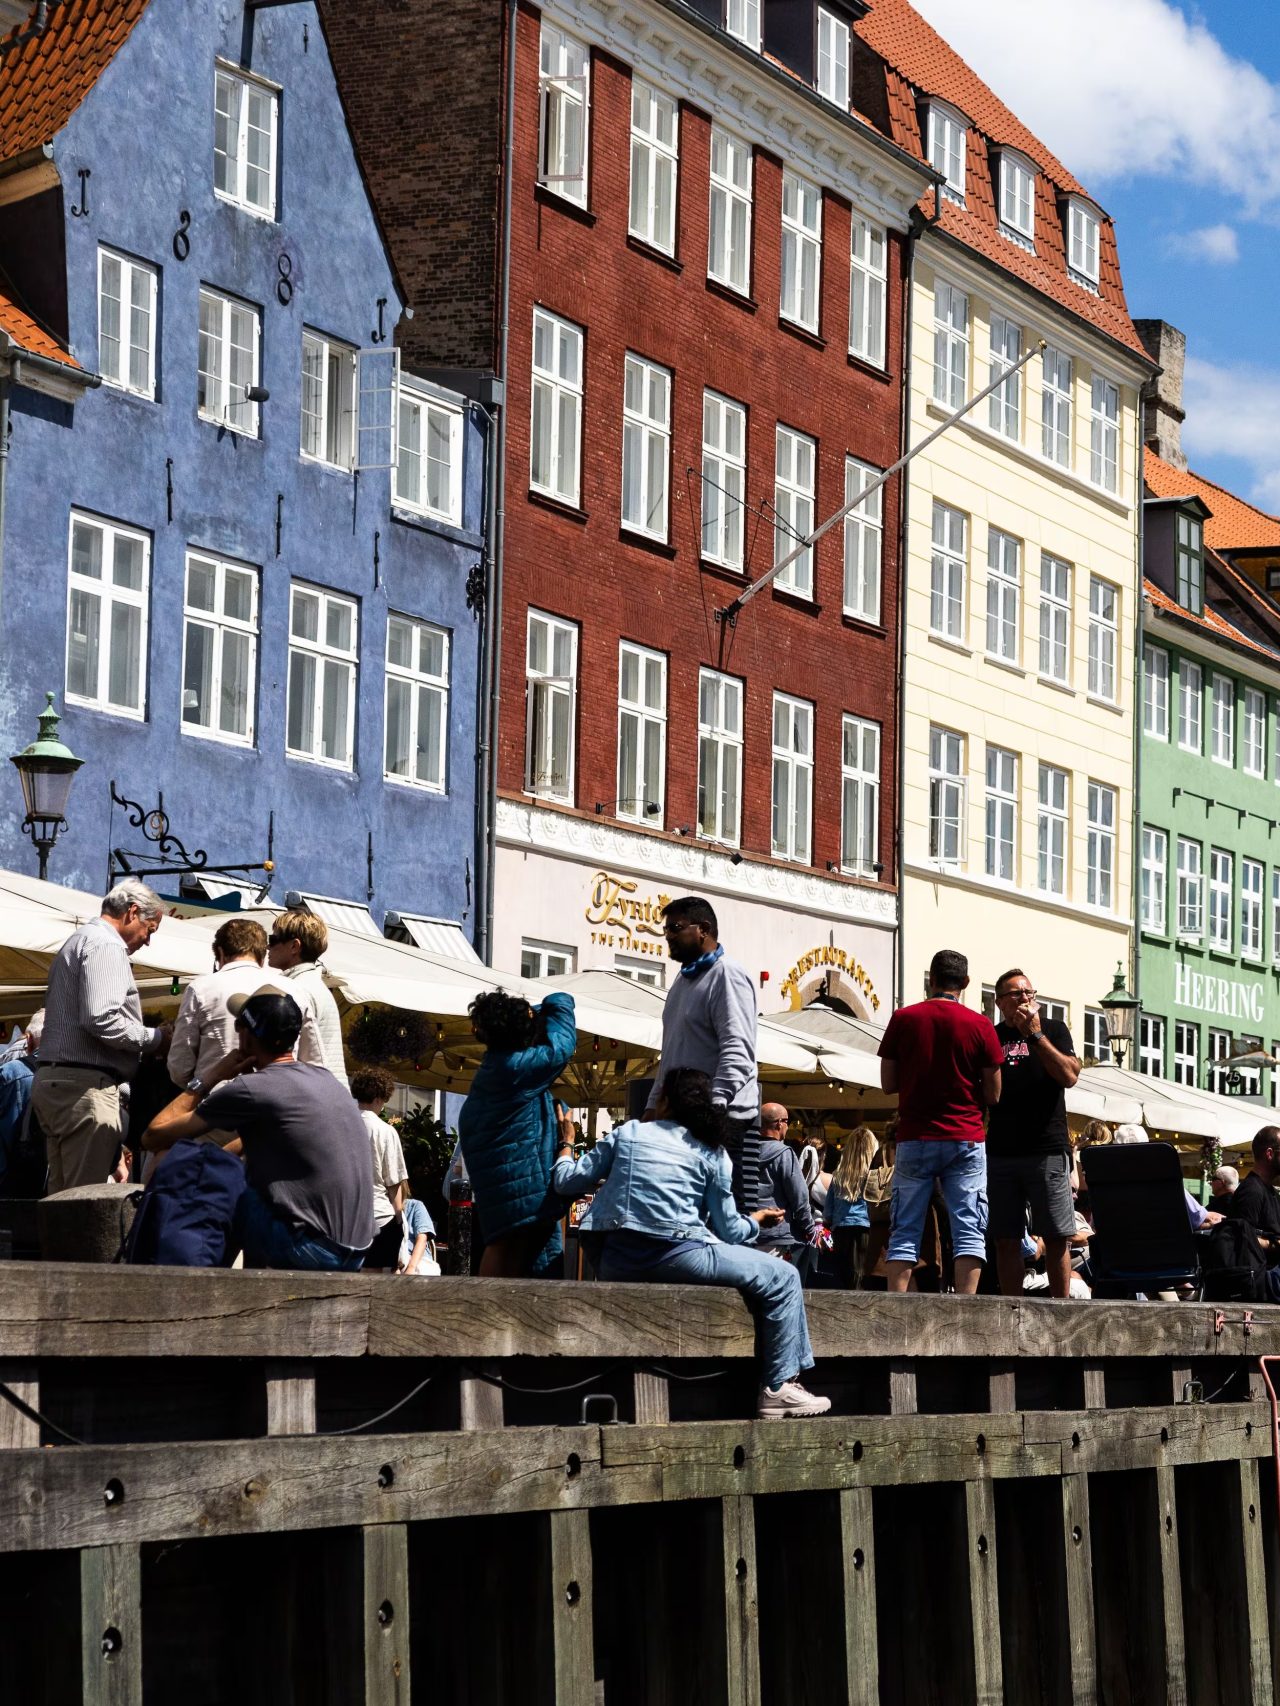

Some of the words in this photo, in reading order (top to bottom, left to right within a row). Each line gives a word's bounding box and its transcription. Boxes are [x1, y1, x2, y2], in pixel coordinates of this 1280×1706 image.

[591, 932, 614, 948] THE
[619, 936, 663, 957] TINDER
[785, 945, 873, 998] RESTAURANT
[1173, 961, 1265, 1023] HEERING
[1229, 1071, 1242, 1083] 15
